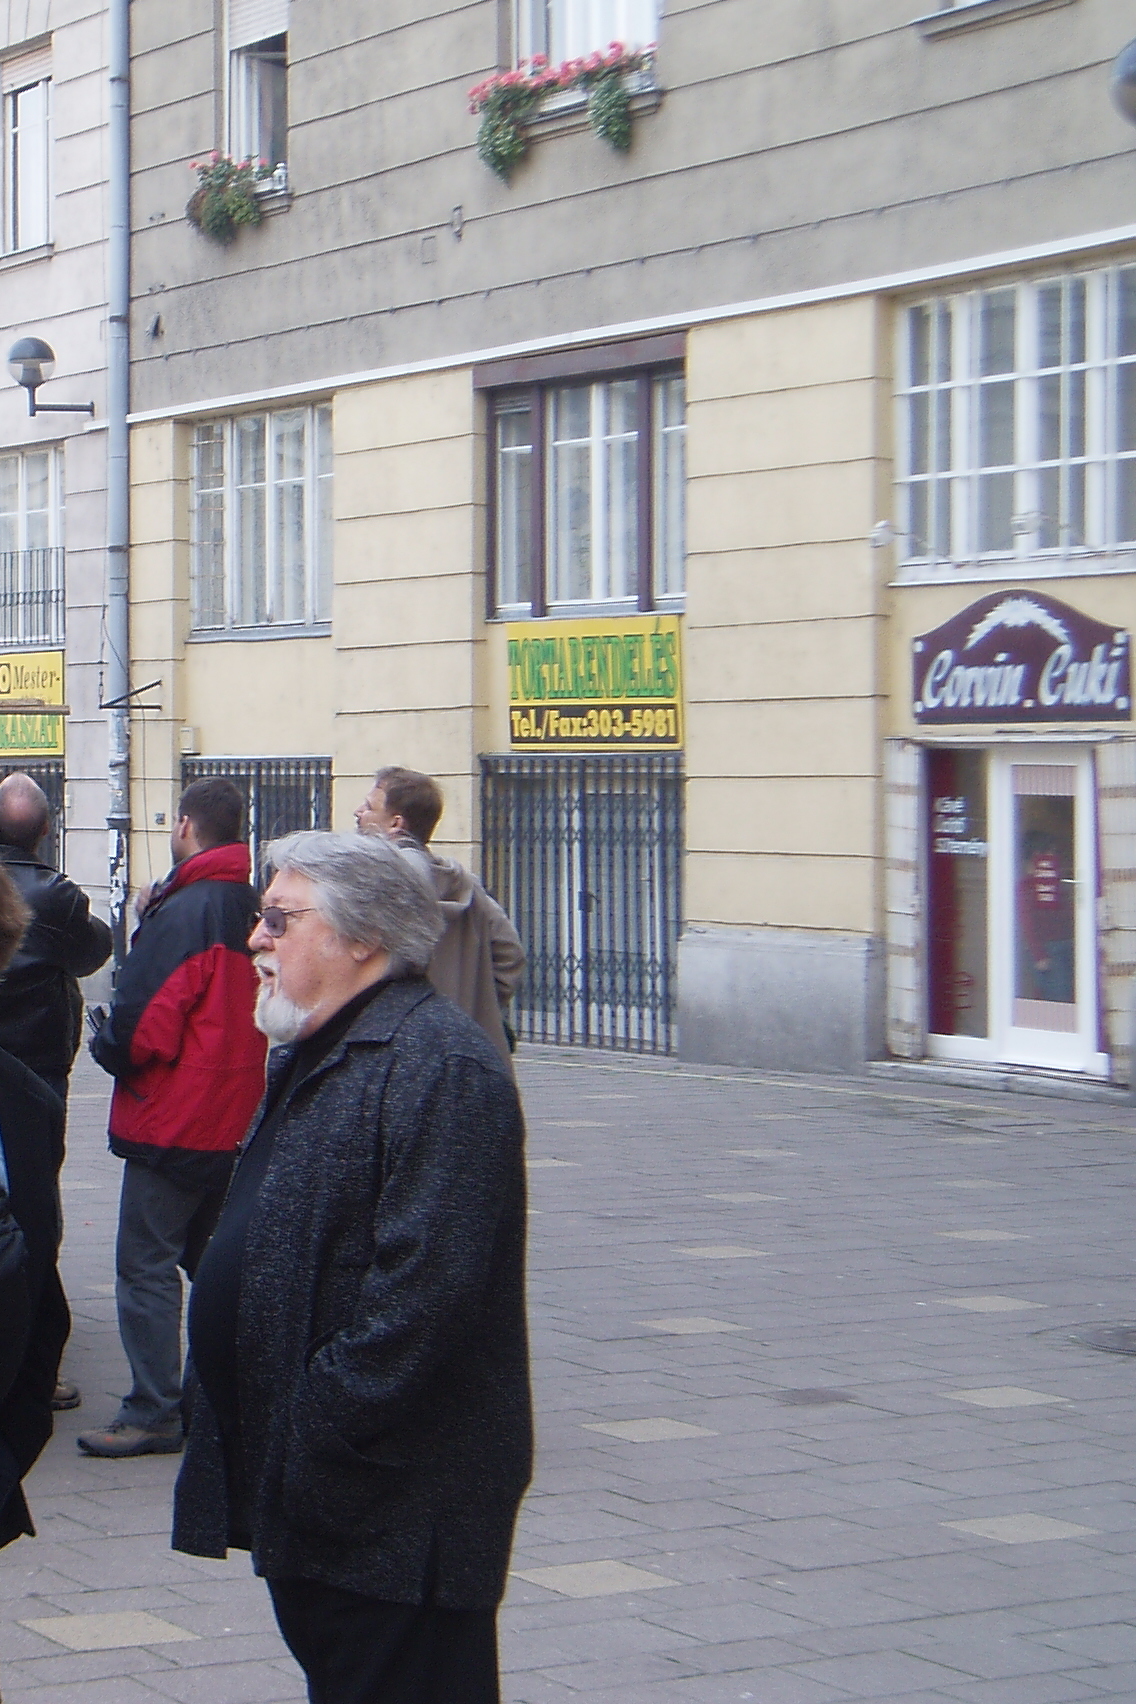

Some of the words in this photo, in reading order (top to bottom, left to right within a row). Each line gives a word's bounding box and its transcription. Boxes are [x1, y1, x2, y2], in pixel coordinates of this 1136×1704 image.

[13, 664, 61, 691] Mester-
[921, 649, 1026, 709] Corvin
[1037, 643, 1126, 707] Cuki
